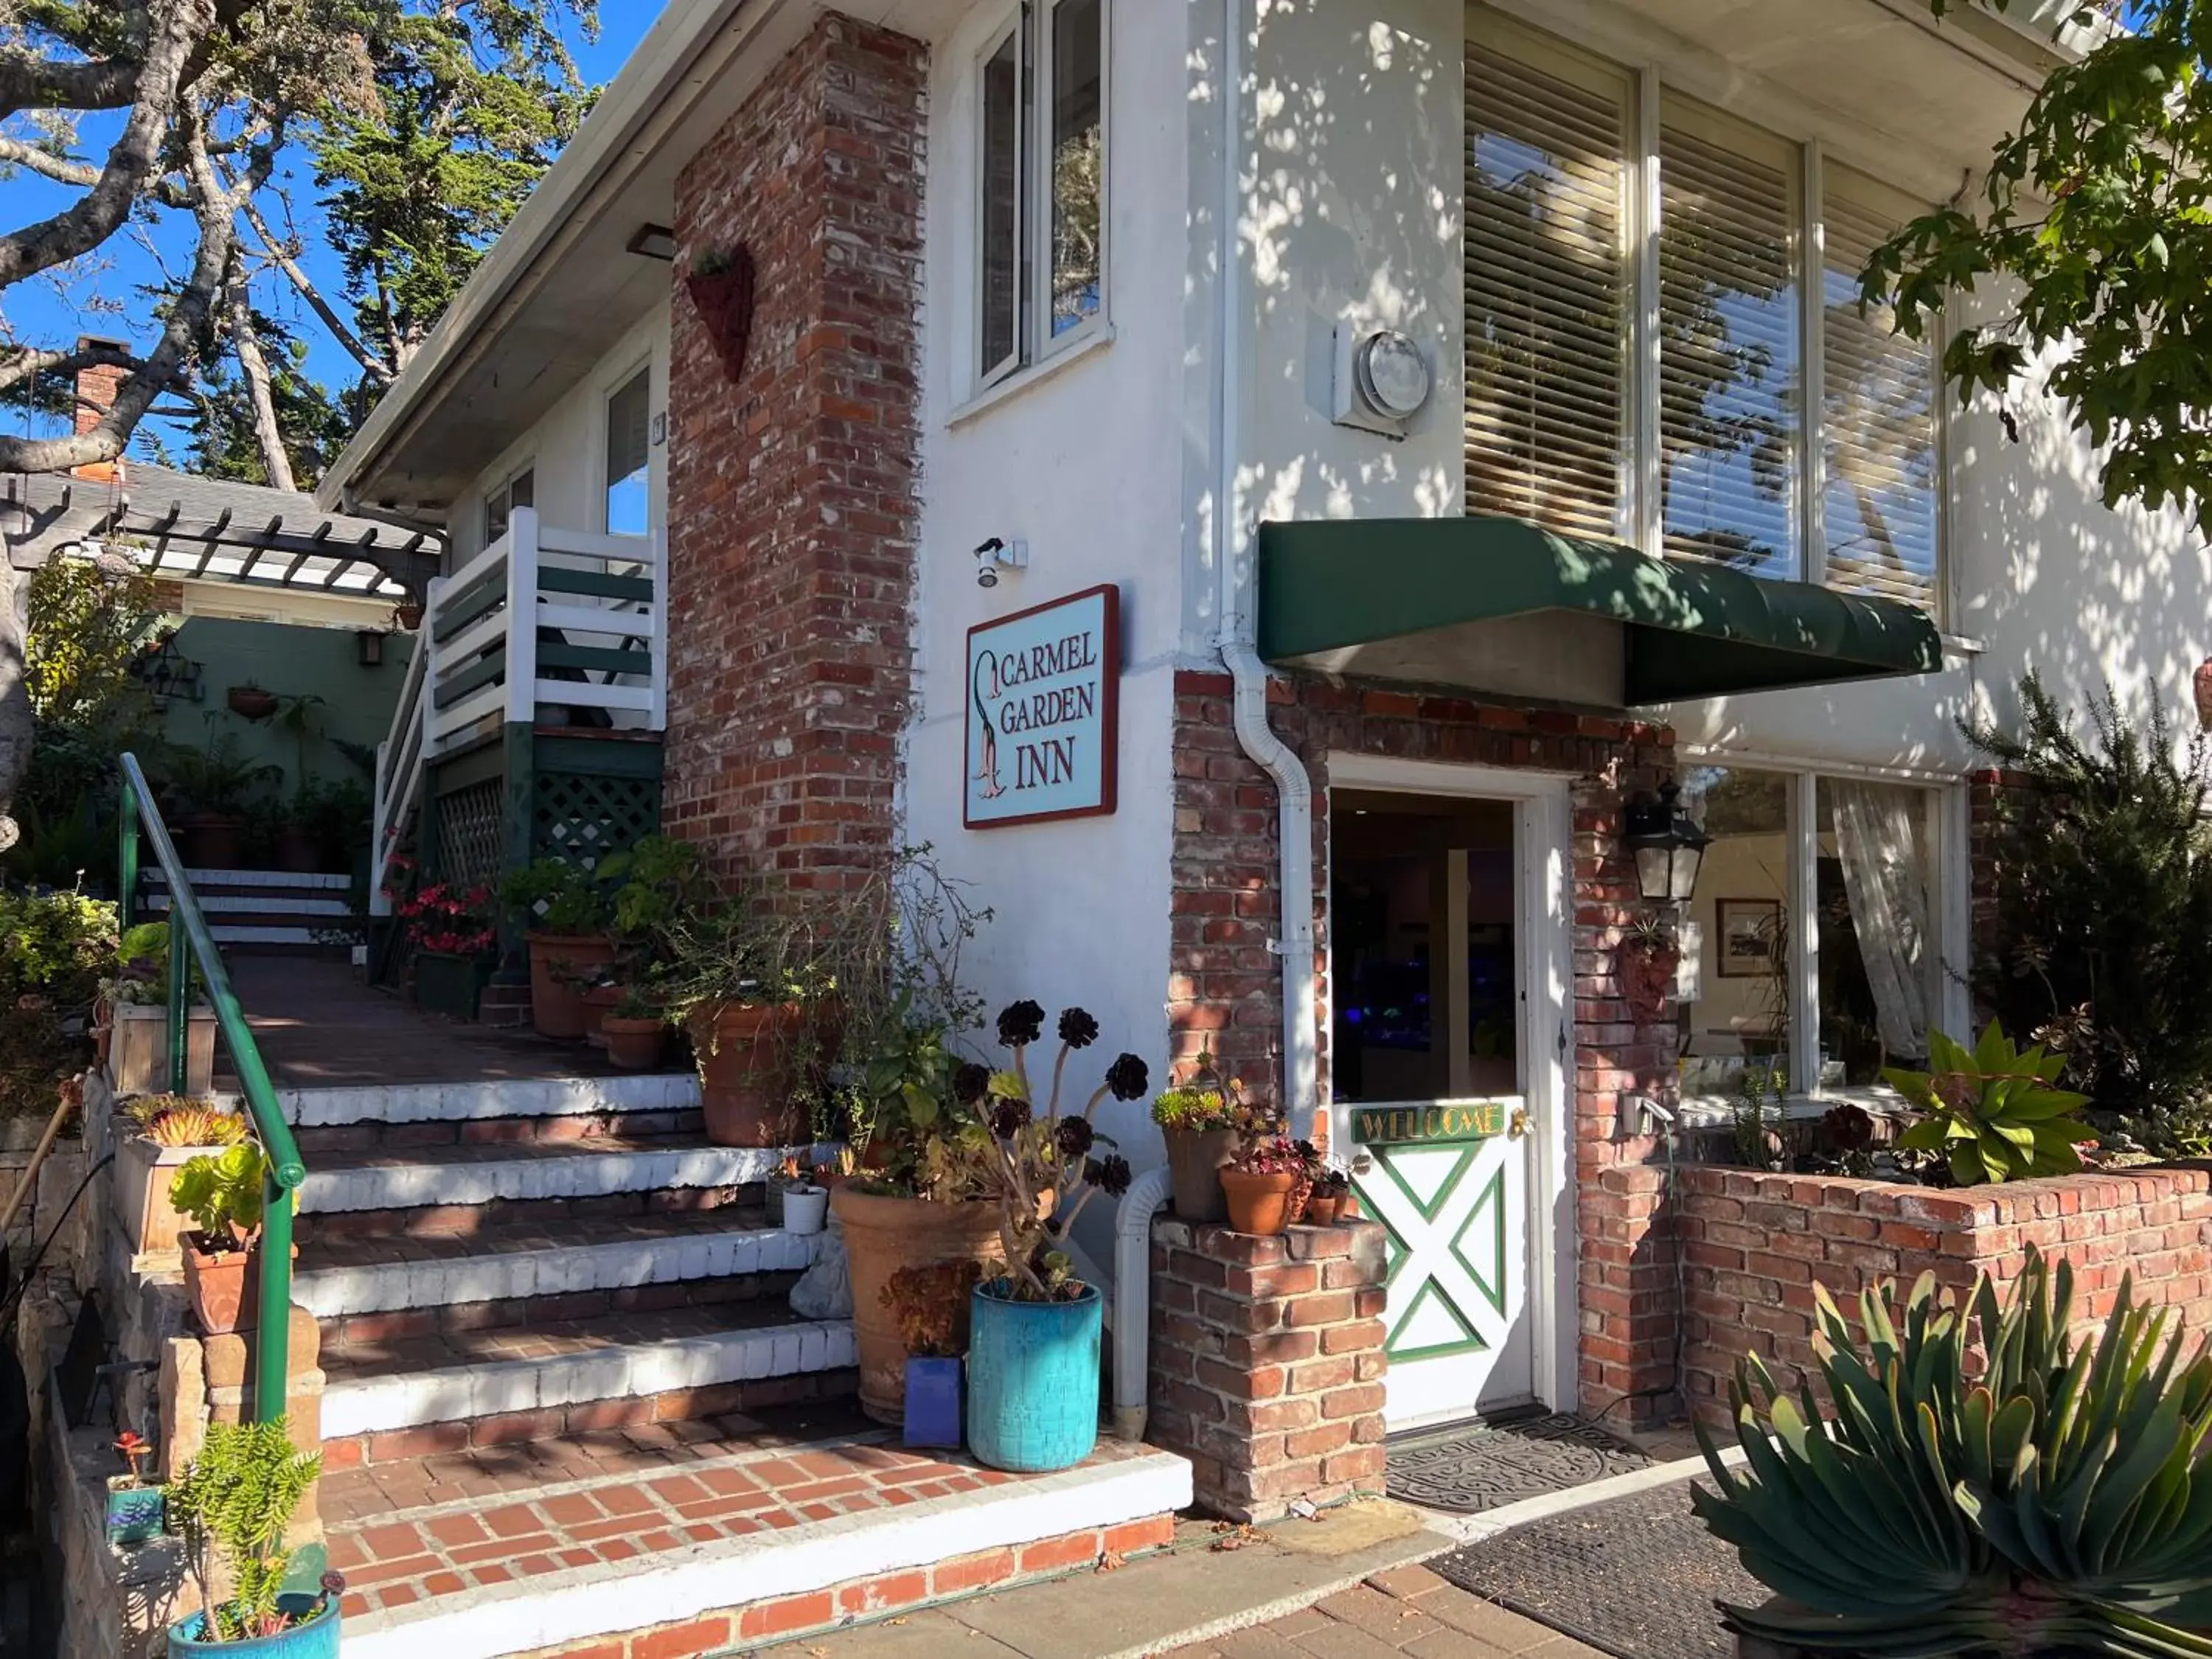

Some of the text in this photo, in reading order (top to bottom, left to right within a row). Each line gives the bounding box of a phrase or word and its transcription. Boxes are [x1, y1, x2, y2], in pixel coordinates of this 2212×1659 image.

[1001, 631, 1096, 687] CARMEL
[1001, 681, 1096, 735] GARDEN
[1015, 736, 1076, 790] INN
[1361, 1106, 1500, 1139] WELCOME
